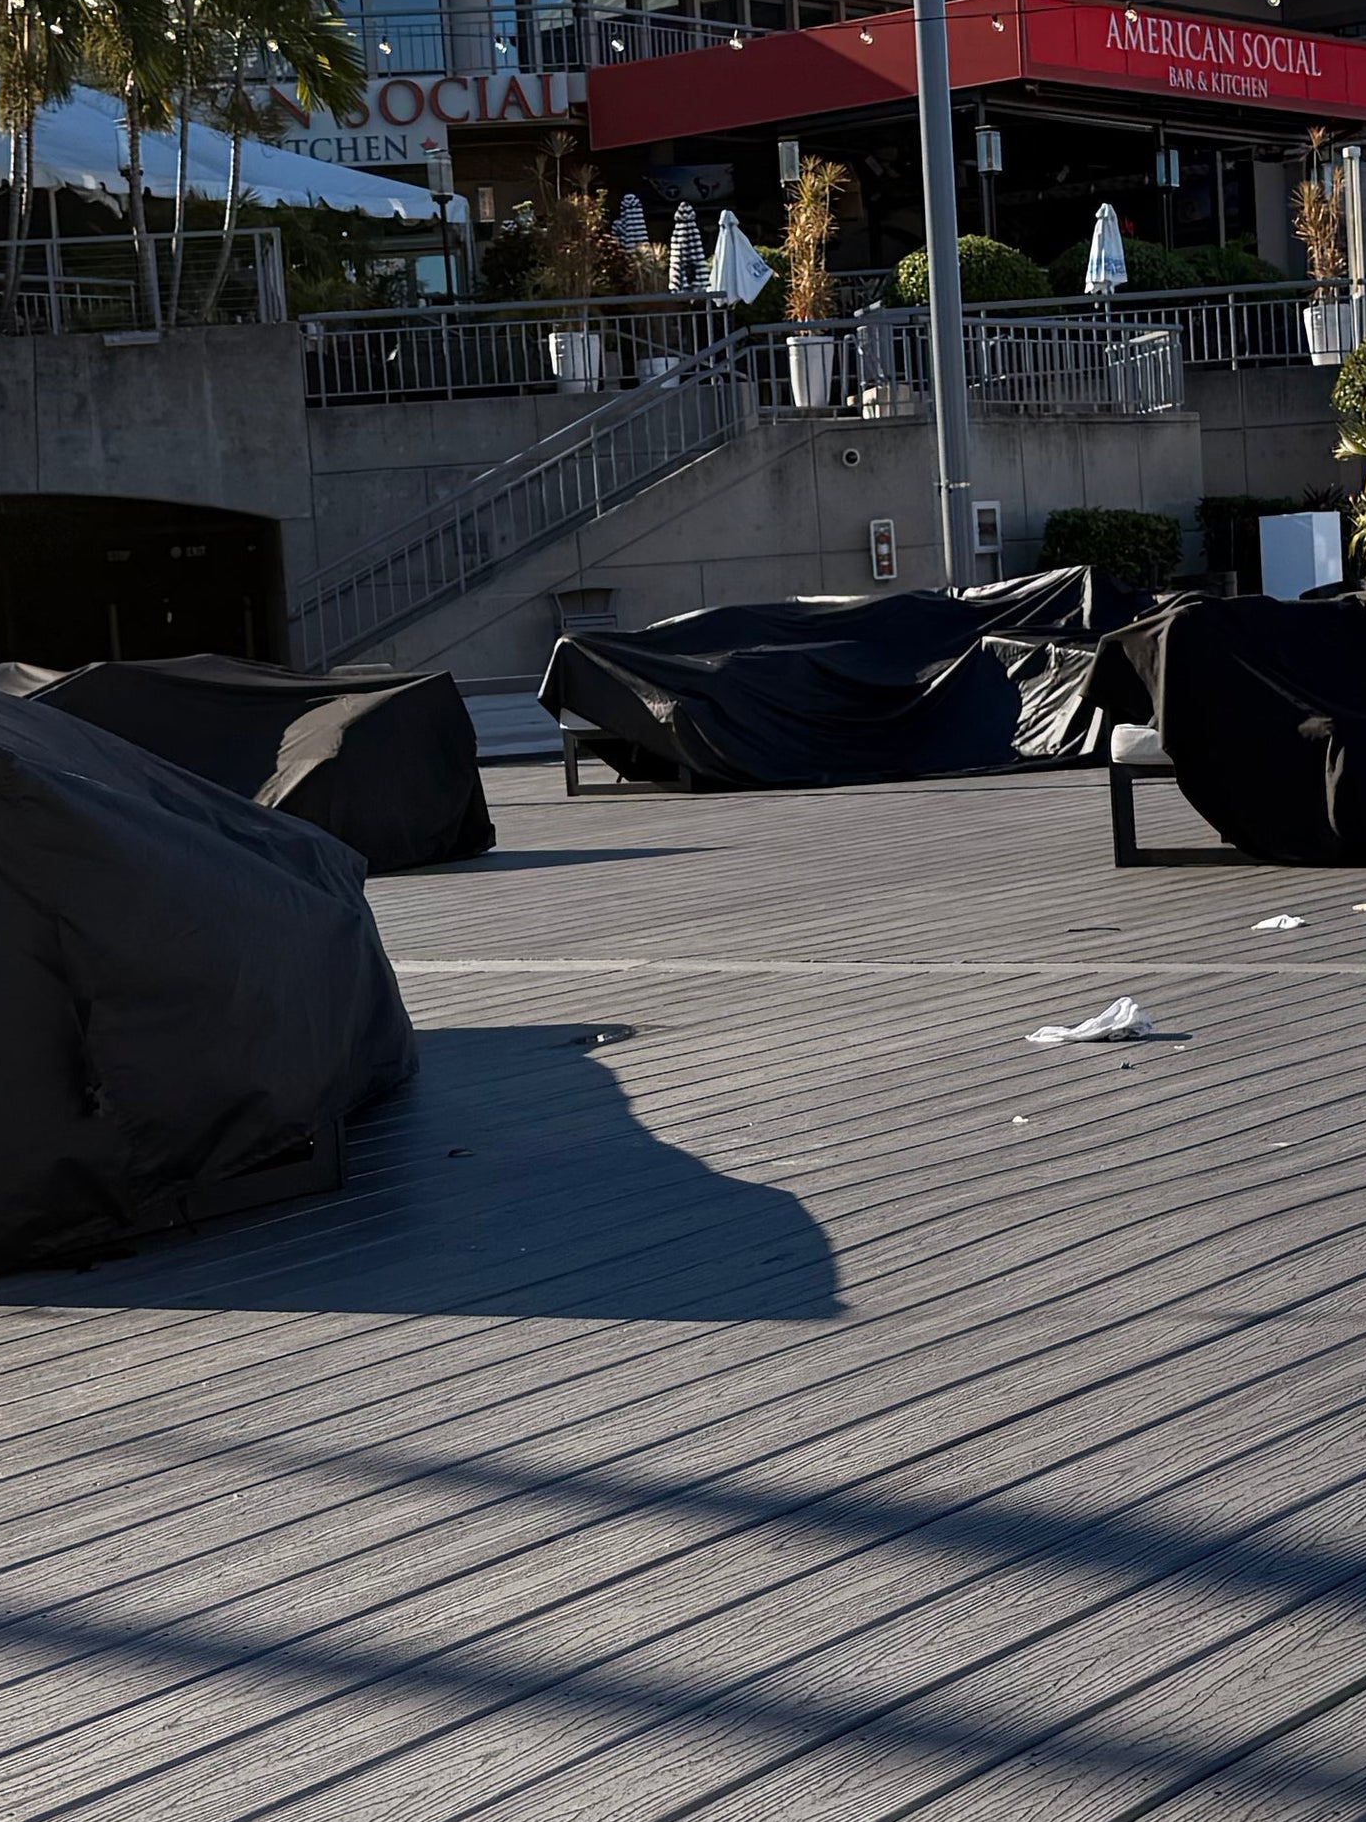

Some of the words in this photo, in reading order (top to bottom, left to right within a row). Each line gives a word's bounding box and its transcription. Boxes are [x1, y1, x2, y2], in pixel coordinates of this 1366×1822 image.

[1106, 12, 1235, 65] AMERICAN
[1242, 32, 1322, 76] SOCIAL
[1168, 66, 1195, 90] BAR
[1198, 72, 1207, 91] &
[1211, 73, 1268, 98] KITCHEN
